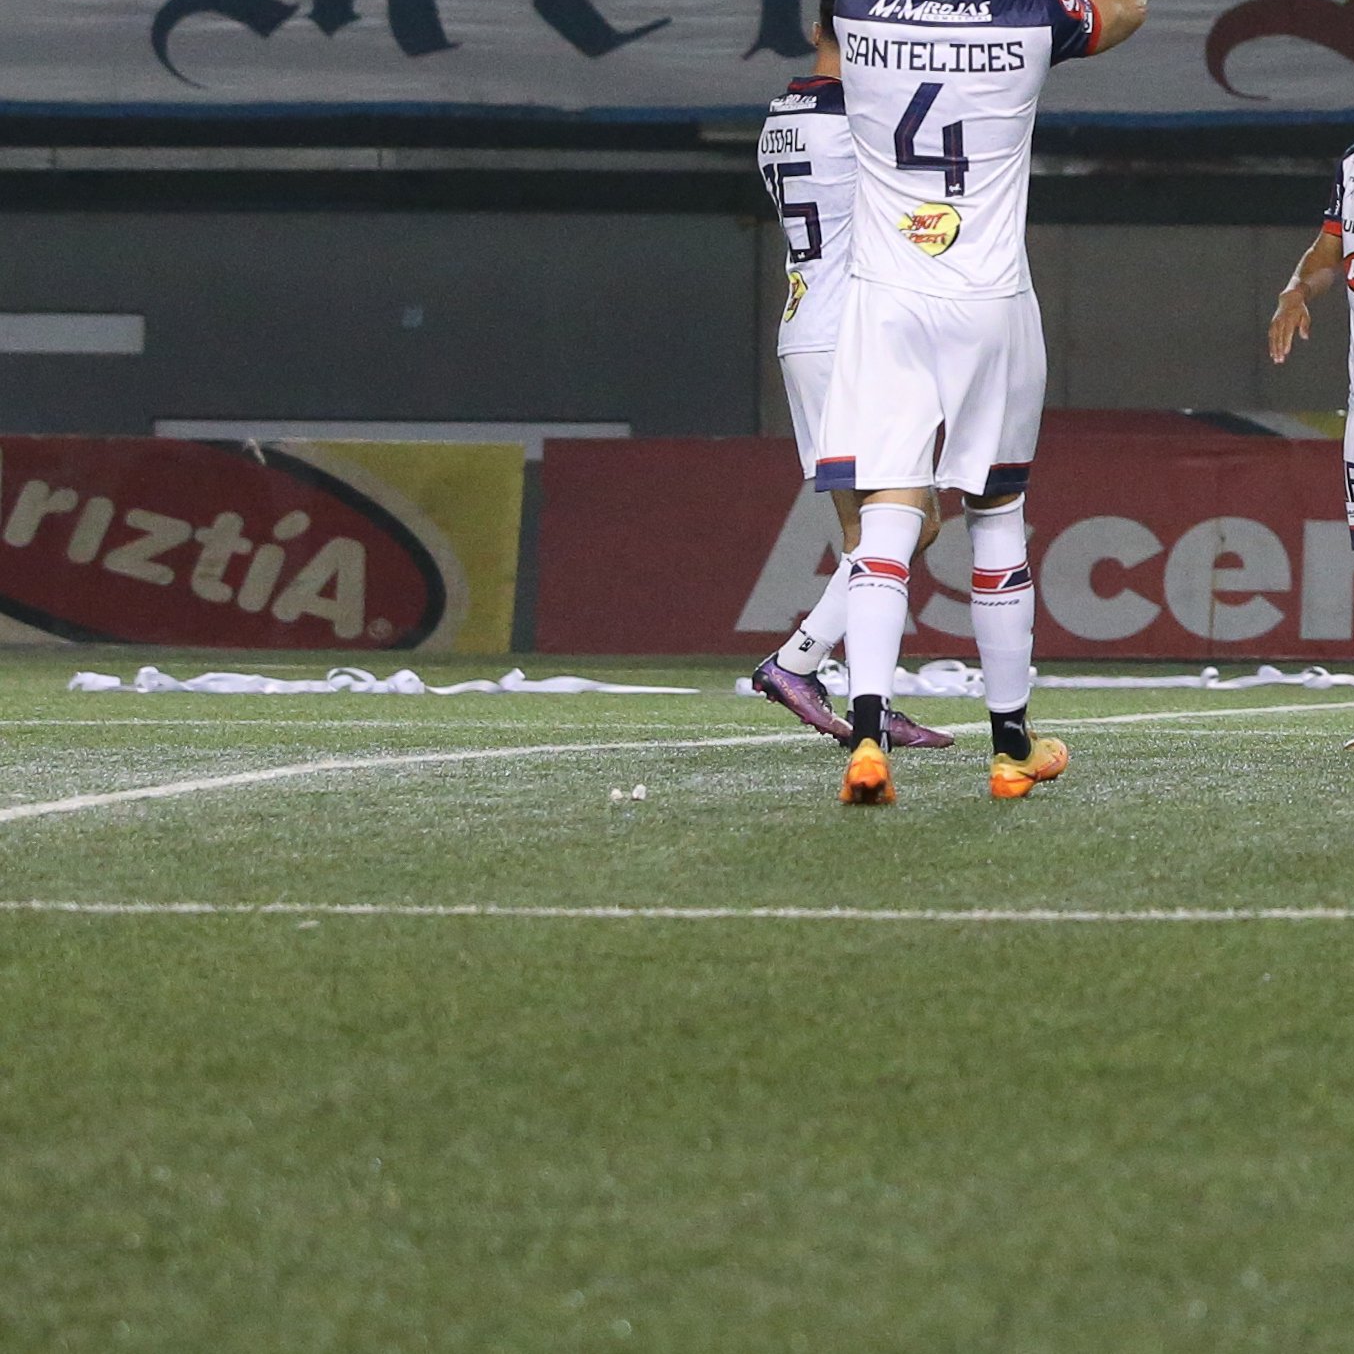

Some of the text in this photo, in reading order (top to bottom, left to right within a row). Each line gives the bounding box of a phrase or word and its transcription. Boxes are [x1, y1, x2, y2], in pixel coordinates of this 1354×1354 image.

[846, 33, 1025, 72] SANTELICES
[894, 82, 969, 197] 4
[763, 161, 822, 263] 15
